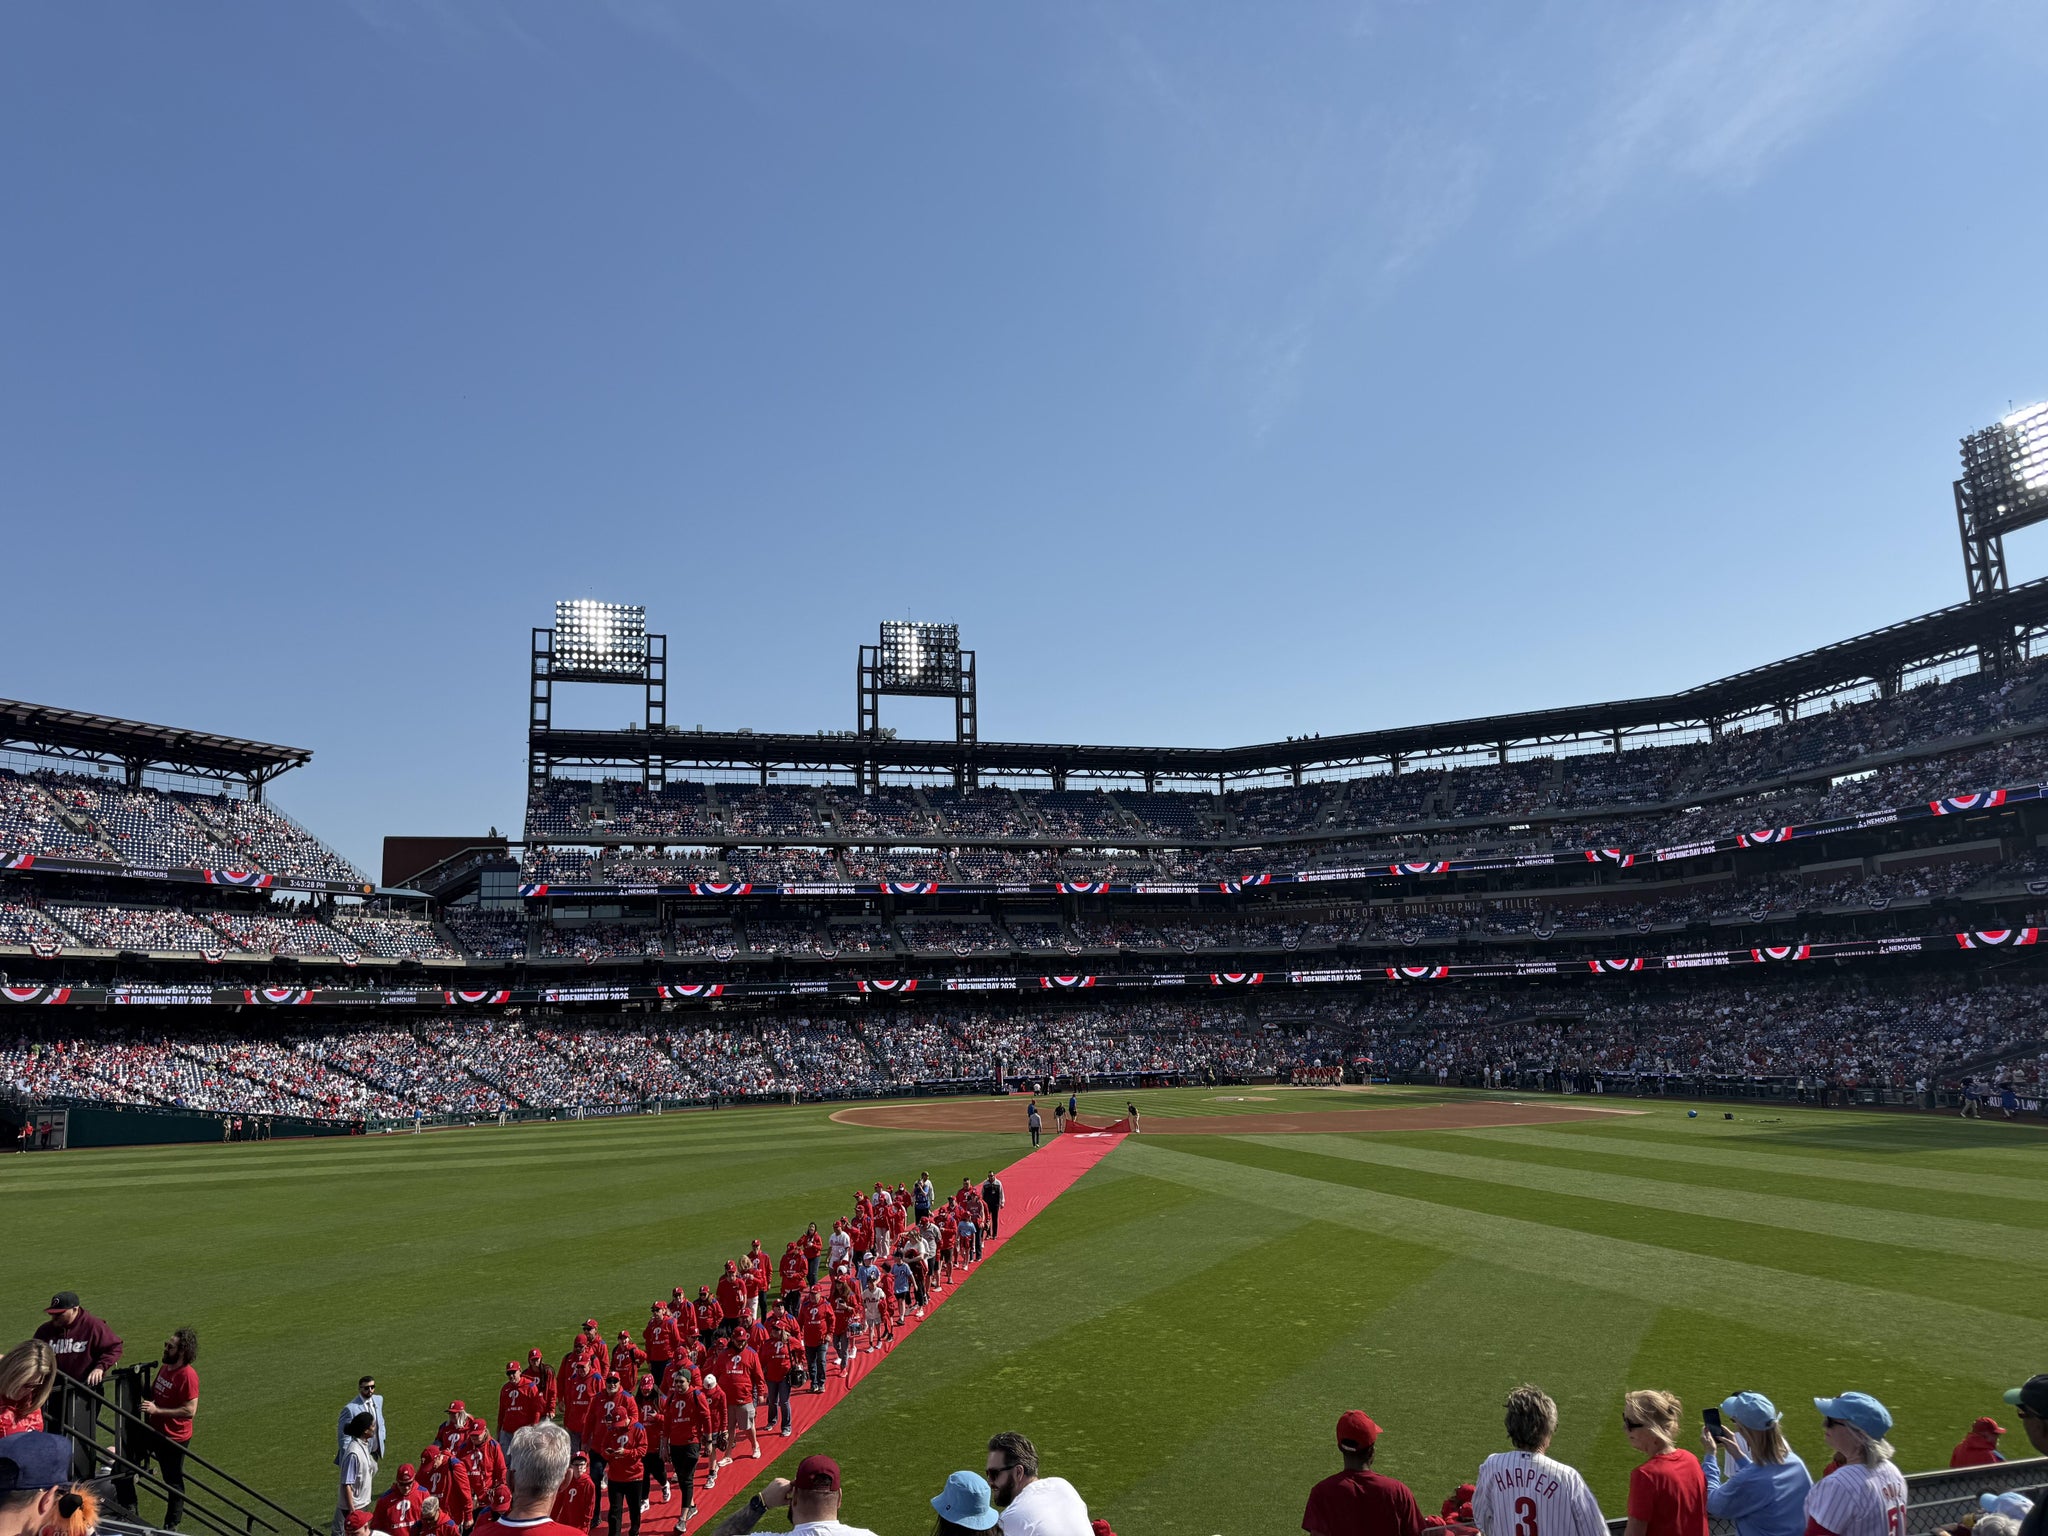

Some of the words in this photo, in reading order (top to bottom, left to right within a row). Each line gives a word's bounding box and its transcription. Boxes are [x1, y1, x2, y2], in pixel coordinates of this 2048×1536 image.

[1866, 815, 1897, 825] NEMOURS
[66, 868, 105, 876] PRESENTED
[133, 870, 169, 878] NEMOURS
[290, 880, 315, 888] 3:43:28
[1329, 908, 1357, 919] HOME
[1362, 907, 1374, 917] OF
[131, 996, 171, 1004] OPENING
[172, 996, 189, 1004] DAY
[190, 996, 212, 1004] 2026
[570, 1106, 613, 1117] GUNGO
[615, 1104, 634, 1113] LAW
[2021, 1099, 2038, 1111] LAW
[788, 1259, 796, 1270] P
[698, 1305, 707, 1315] P
[810, 1307, 819, 1320] P
[653, 1327, 661, 1340] P
[49, 1338, 88, 1354] hillies
[775, 1341, 784, 1354] P
[617, 1353, 625, 1366] P
[731, 1355, 742, 1370] P
[509, 1390, 519, 1406] P
[576, 1384, 586, 1399] P
[604, 1401, 615, 1416] P
[675, 1400, 686, 1417] P
[448, 1433, 460, 1450] P
[617, 1435, 629, 1449] P
[471, 1451, 483, 1470] P
[430, 1472, 441, 1493] P
[1494, 1467, 1559, 1499] HARPER
[569, 1488, 578, 1502] P
[397, 1499, 411, 1521] P
[1514, 1496, 1539, 1536] 3
